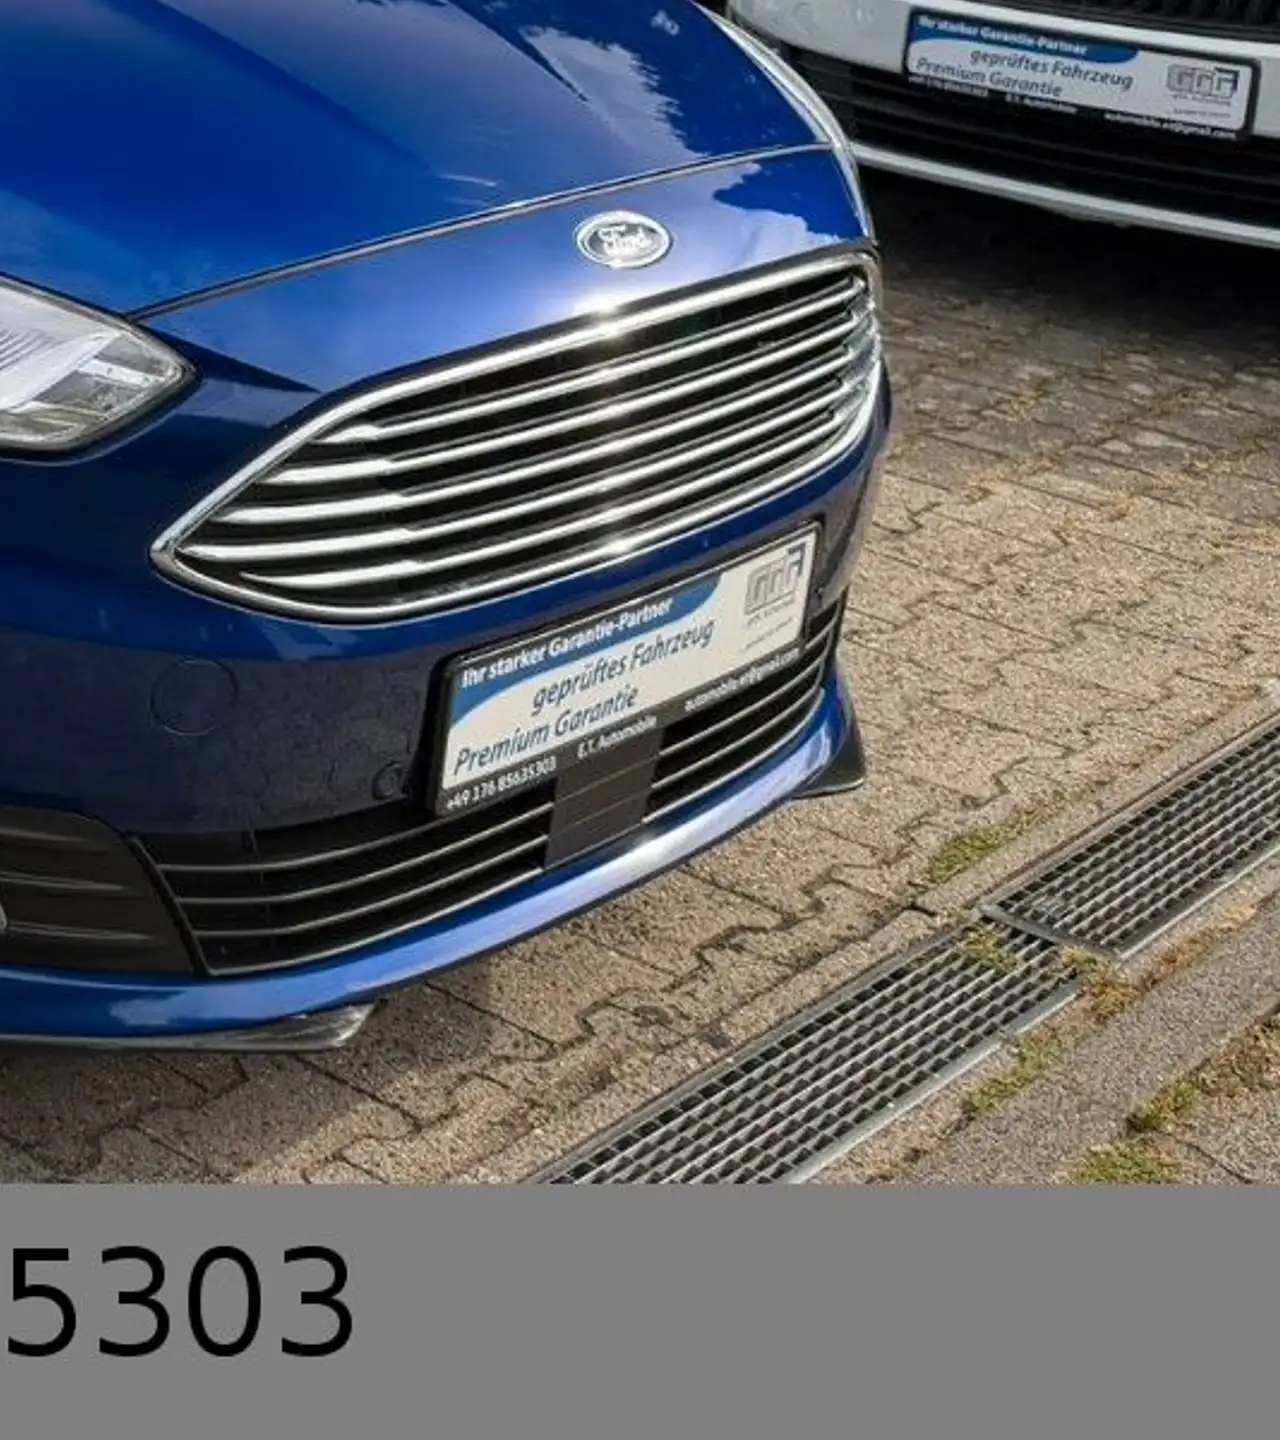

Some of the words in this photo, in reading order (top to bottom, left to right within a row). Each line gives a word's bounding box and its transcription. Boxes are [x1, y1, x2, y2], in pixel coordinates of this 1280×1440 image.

[916, 57, 986, 84] Premium
[990, 71, 1063, 97] Garantie
[970, 49, 1049, 75] geprüftes
[1051, 60, 1134, 93] Fahrzeug
[462, 667, 488, 689] Ihr
[489, 645, 547, 680] starker
[548, 598, 674, 656] Garantie-Partner
[531, 655, 628, 717] geprüftes
[630, 618, 715, 670] Fahrzeug
[453, 721, 550, 776] Premium
[555, 684, 639, 737] Garantie
[472, 779, 496, 802] 176
